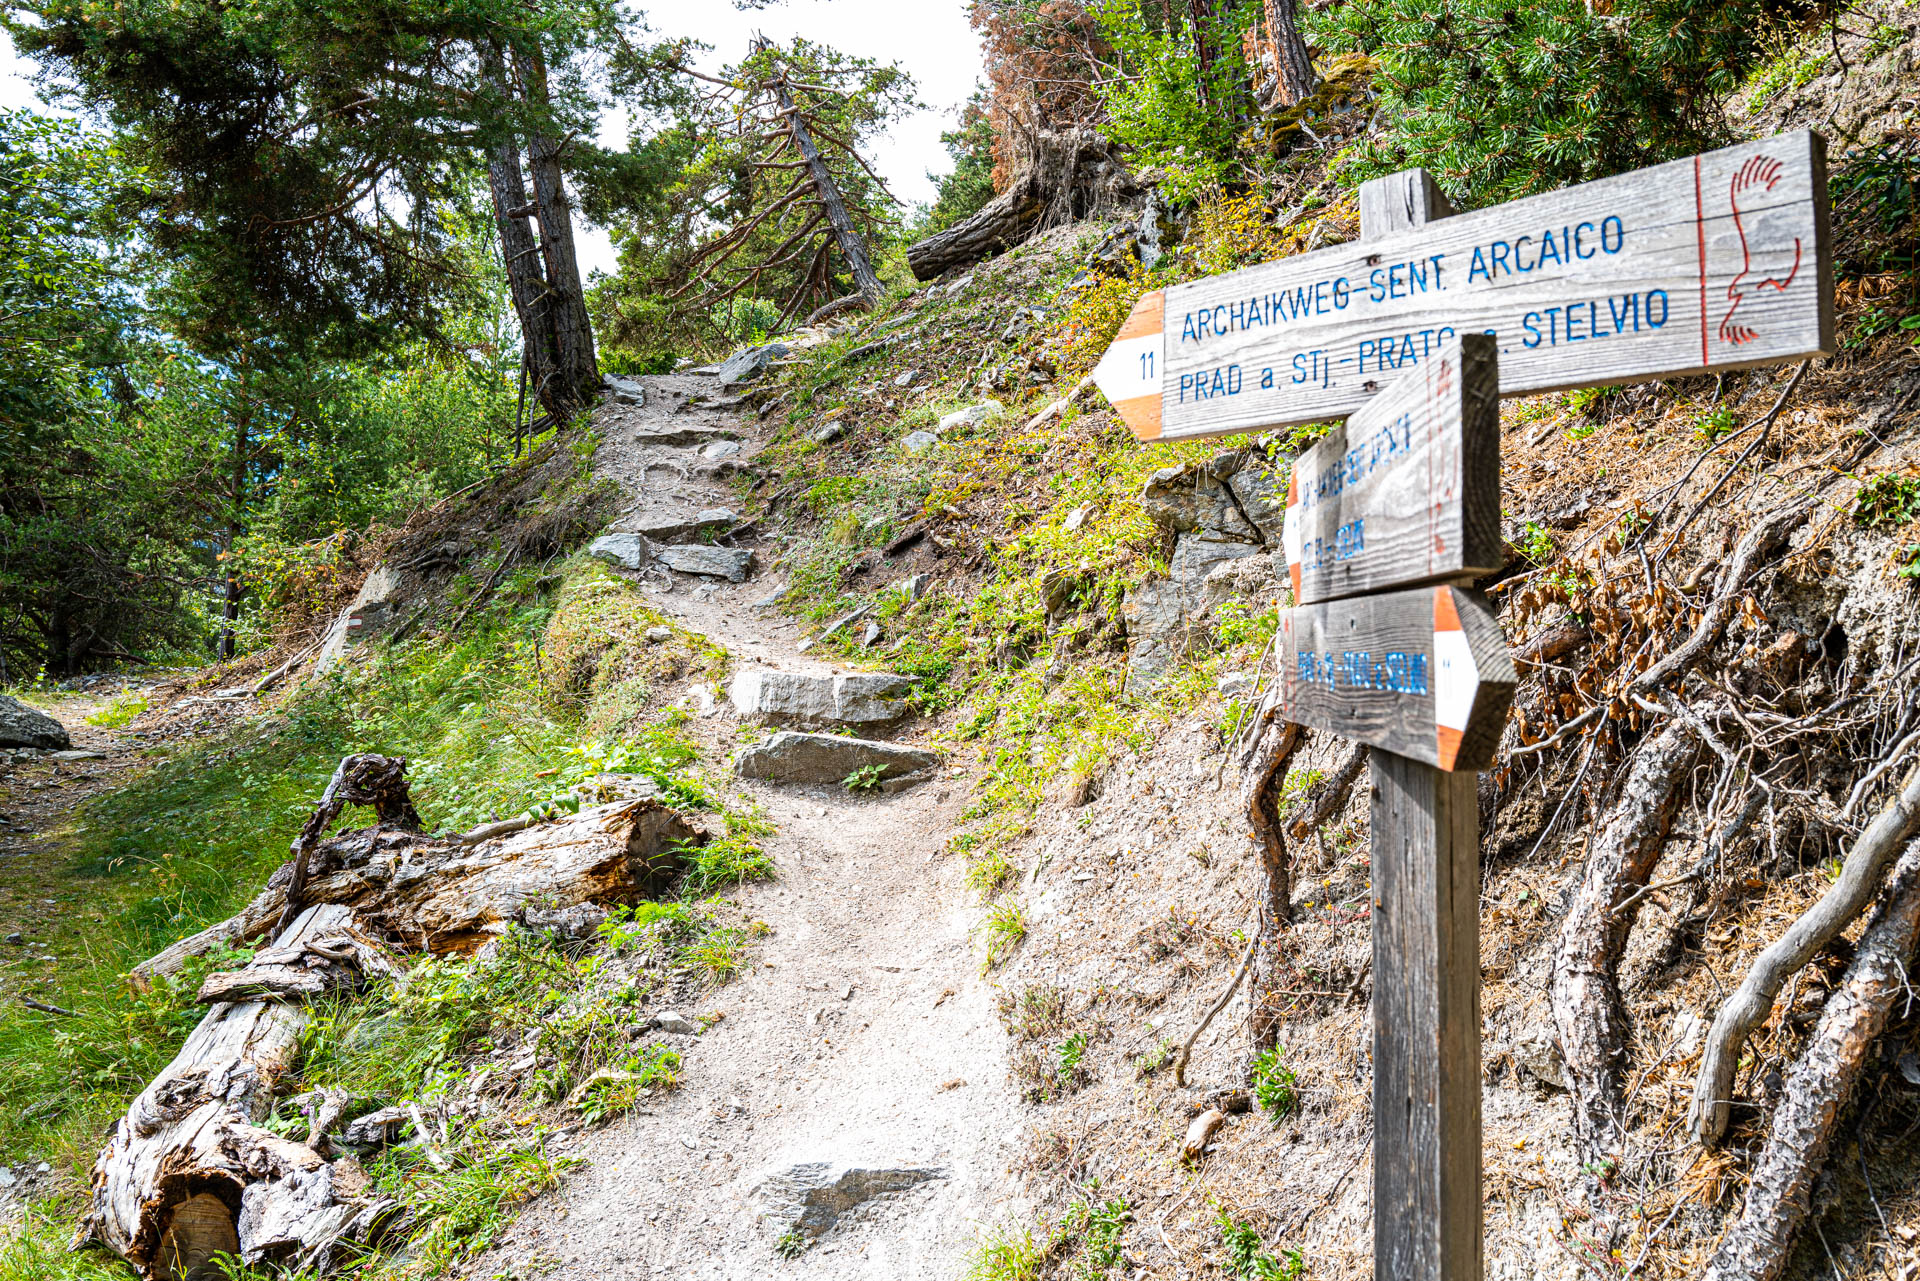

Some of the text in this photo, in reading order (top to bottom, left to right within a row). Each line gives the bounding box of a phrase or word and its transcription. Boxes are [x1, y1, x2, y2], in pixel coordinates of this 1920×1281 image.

[1468, 215, 1624, 283] ARCAICO
[1139, 351, 1155, 380] 11
[1179, 364, 1242, 403] PRAD
[1260, 367, 1281, 390] a.
[1522, 288, 1669, 348] STELVIO
